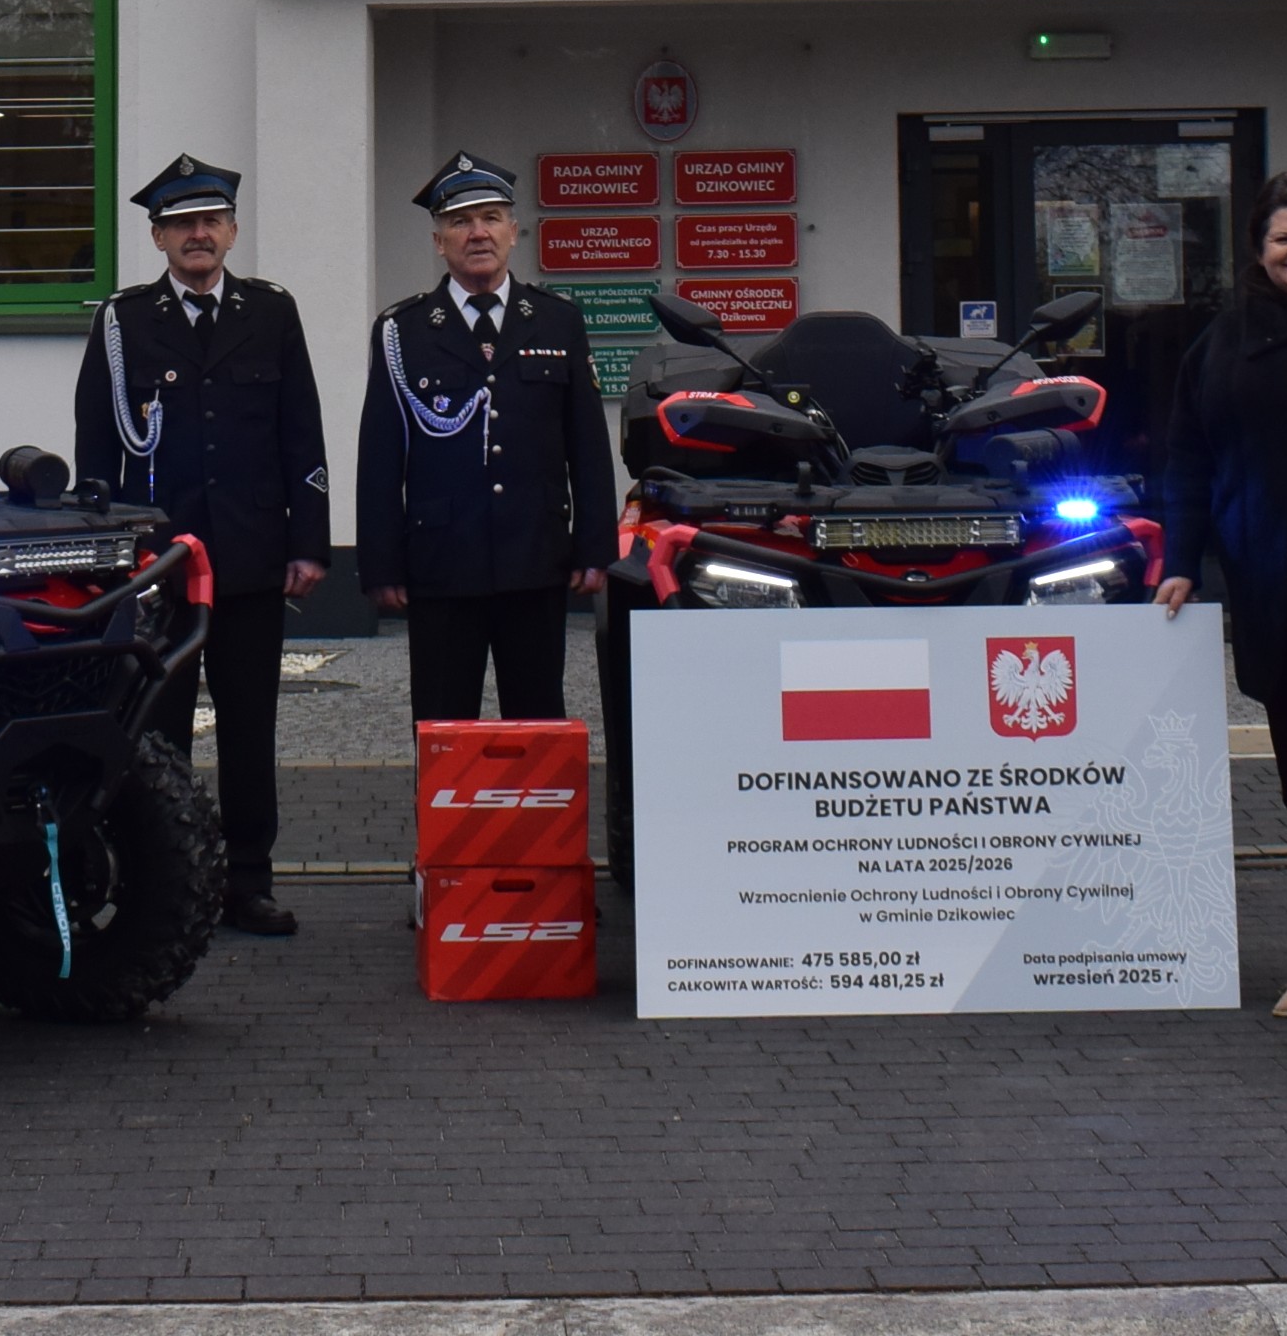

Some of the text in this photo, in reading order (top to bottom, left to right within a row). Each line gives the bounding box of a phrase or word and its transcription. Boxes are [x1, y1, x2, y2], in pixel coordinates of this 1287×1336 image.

[553, 165, 643, 178] RADA GMINY
[684, 162, 785, 177] URZĄD GMINY
[559, 182, 639, 195] DZIKOWIEC
[696, 180, 775, 193] DZIKOWIEC
[581, 227, 618, 239] URZĄD
[696, 222, 777, 235] Czas pracy Urzędu
[548, 237, 652, 249] STANU CYWILNEGO
[749, 237, 759, 246] do
[570, 249, 630, 260] w Dzikowcu
[707, 250, 730, 260] 7.30
[739, 249, 766, 259] 15.30
[575, 288, 652, 298] BANK SPÓŁDZIELCZY
[691, 286, 784, 299] GMINNY OŚRODEK
[730, 299, 792, 310] SPOŁECZNEJ
[596, 313, 653, 324] DZIKOWIEC
[721, 311, 766, 322] Dzikowcu
[737, 761, 1126, 792] DOFINANSOWANO ZE ŚRODKÓW
[430, 789, 575, 808] LS2
[815, 790, 1051, 819] BUDŻETU PAŃSTWA
[727, 839, 808, 854] PROGRAM
[813, 838, 893, 853] OCHRONY
[898, 832, 978, 851] LUDNOŚCI
[989, 834, 1057, 850] OBRONY
[1061, 832, 1142, 848] CYWILNEJ
[858, 856, 1014, 874] NA LATA 2025/2026
[738, 889, 846, 905] Wzmocnienie
[850, 888, 918, 907] Ochrony
[922, 884, 993, 902] Ludności
[1004, 885, 1063, 903] Obrony
[1066, 883, 1135, 902] Cywilnej
[859, 906, 1016, 924] w Gminie Dzikowiec
[440, 921, 584, 942] LS2
[667, 950, 920, 970] DOFINANSOWANIE: 475 585,00 zł
[1023, 951, 1187, 968] Data podpisania umowy
[667, 972, 945, 993] CAŁKOWITA WARTOŚĆ: 594 481,25 zł
[1033, 968, 1179, 986] wrzesień 2025 r.
